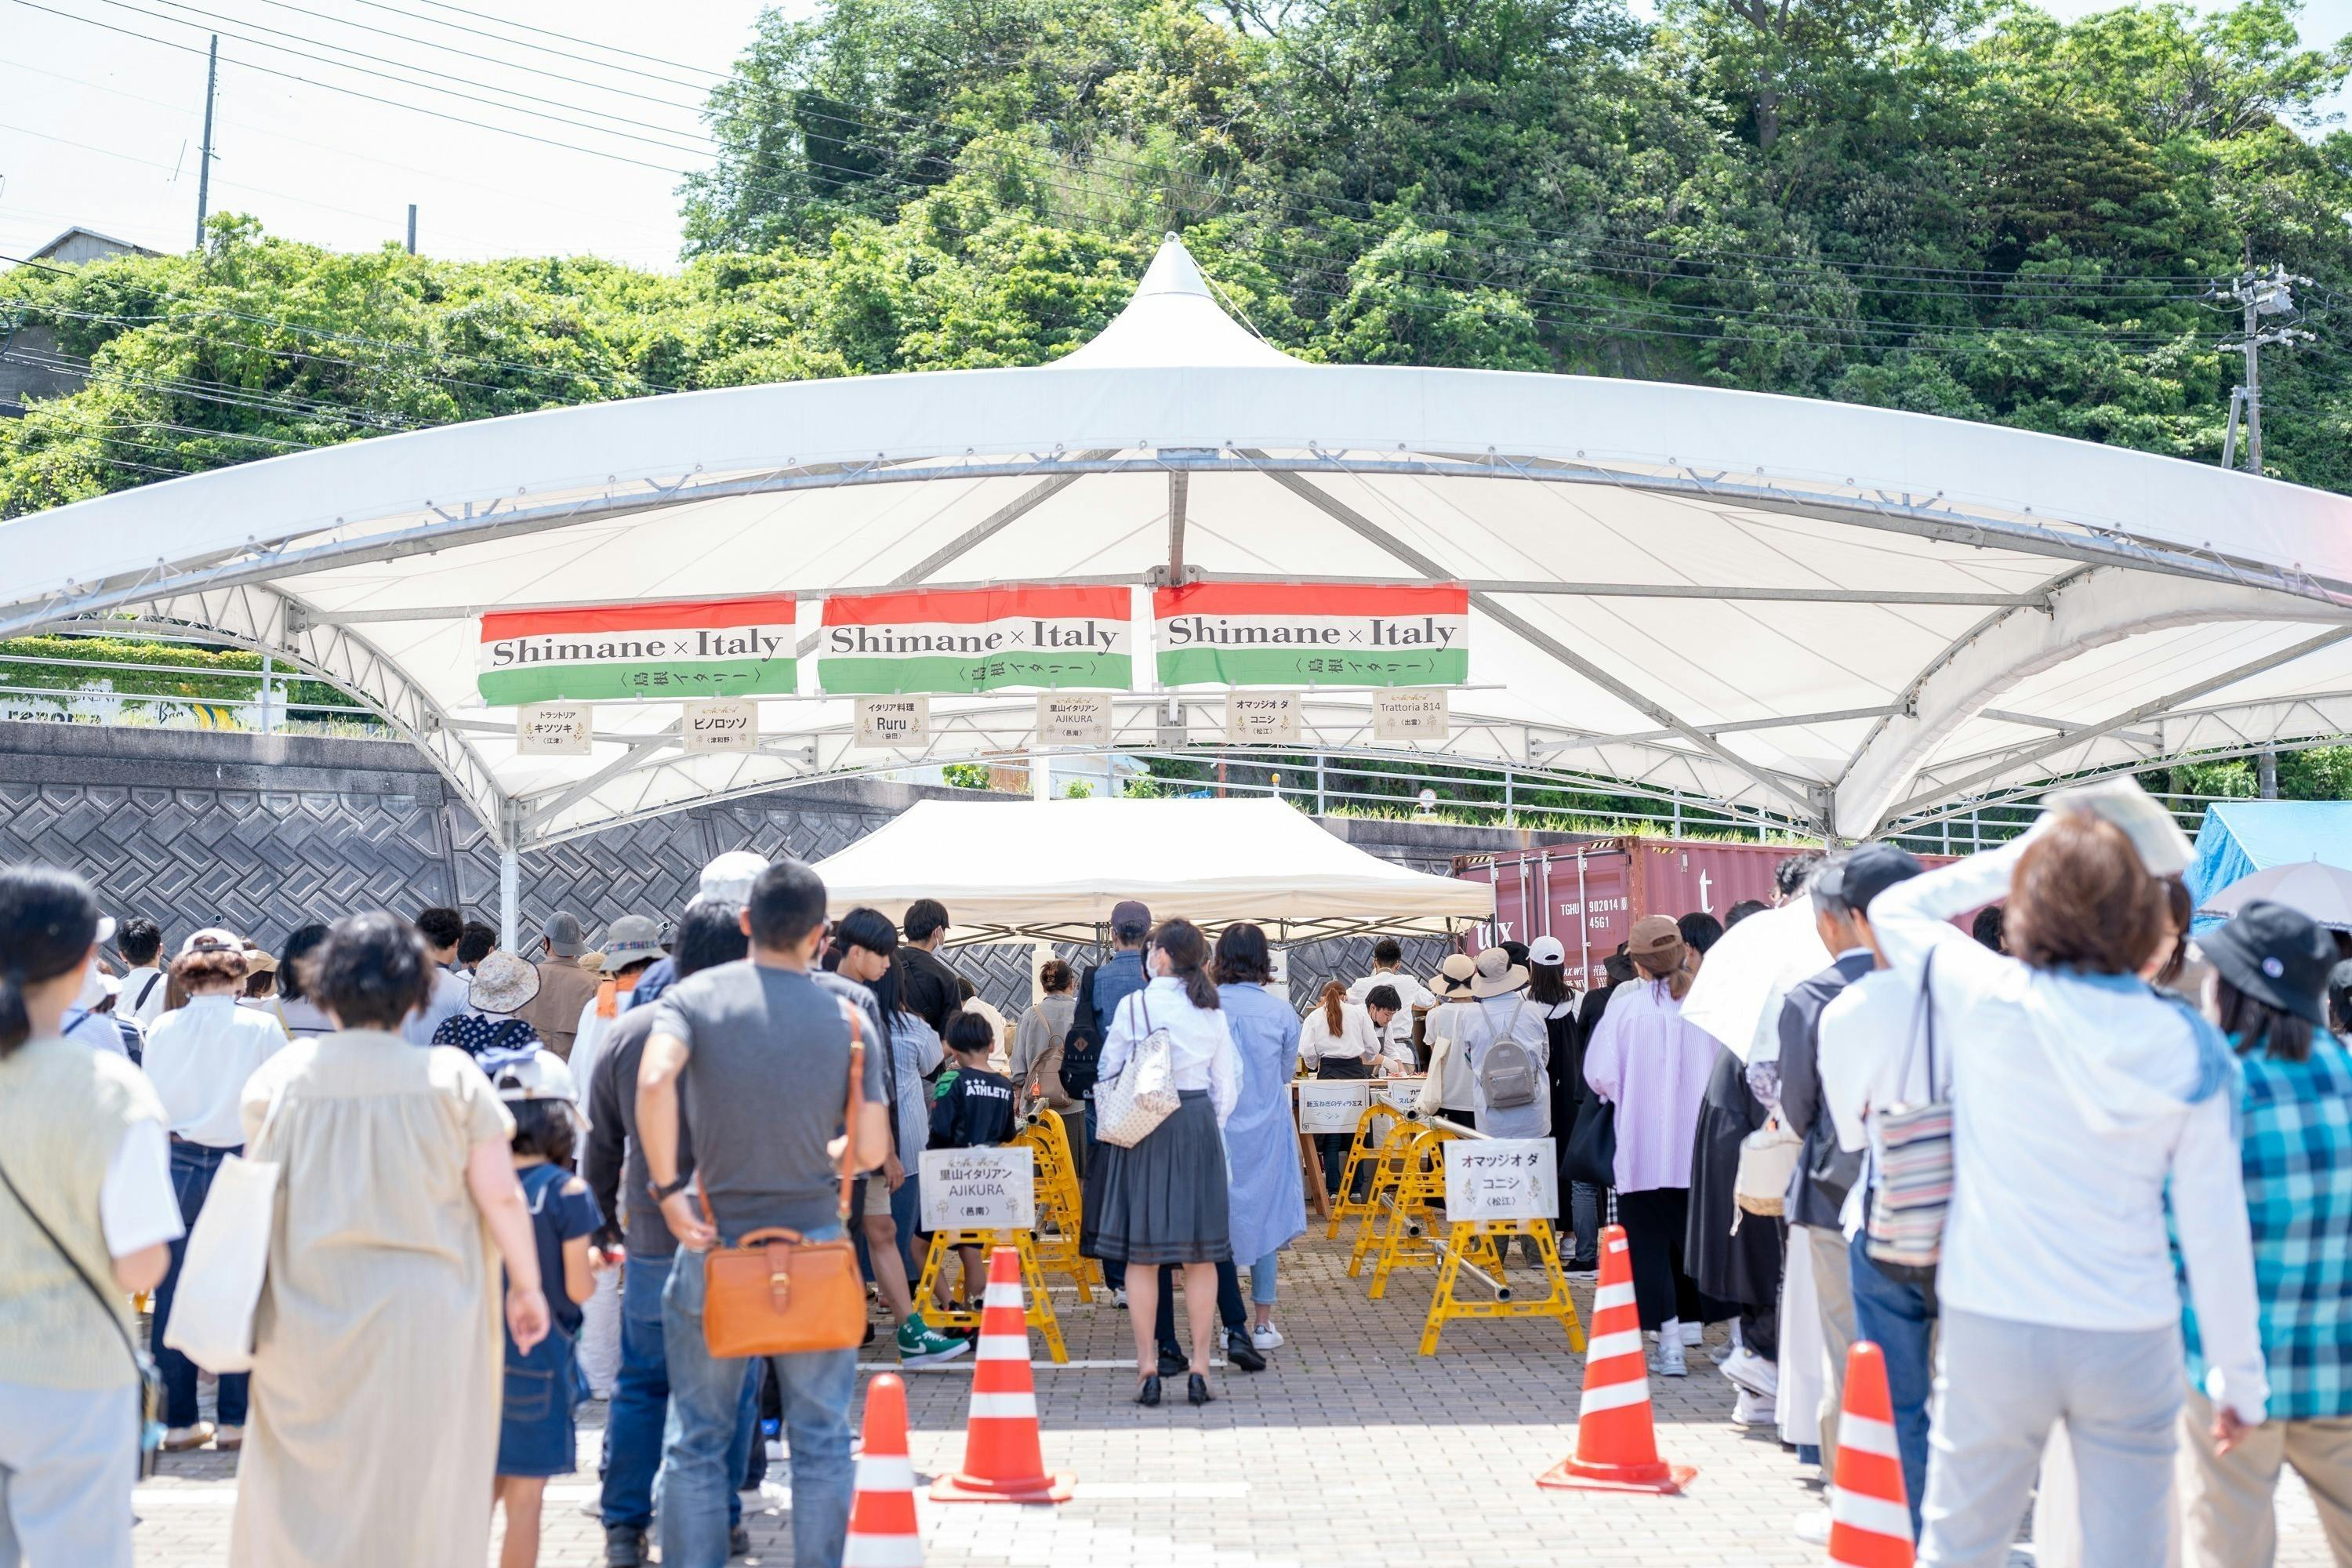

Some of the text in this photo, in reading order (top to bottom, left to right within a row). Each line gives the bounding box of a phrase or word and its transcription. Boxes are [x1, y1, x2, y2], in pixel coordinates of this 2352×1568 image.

[831, 627, 1003, 653] Shimane
[1031, 621, 1120, 656] Italy
[1169, 617, 1340, 645] Shimane
[1369, 618, 1457, 653] Italy
[492, 638, 666, 666] Shimane
[695, 629, 783, 662] Italy
[868, 703, 915, 712] イタリア料理
[1236, 699, 1289, 709] オマッジオ ダ
[1380, 702, 1440, 712] Trattoria 814
[695, 717, 746, 730] ピノロッソ
[877, 717, 906, 730] Ruru
[1250, 715, 1276, 724] コニシ
[534, 724, 572, 733] キツツキ
[1699, 868, 1715, 914] t
[1560, 903, 1580, 916] TGHU
[1588, 898, 1618, 913] 902014
[1589, 916, 1610, 928] 45G1
[1462, 1152, 1539, 1168] オマッジオ ダ
[939, 1168, 1013, 1181] 里山イタリアン
[949, 1184, 1005, 1196] AJIKURA
[1483, 1177, 1520, 1190] コニシ
